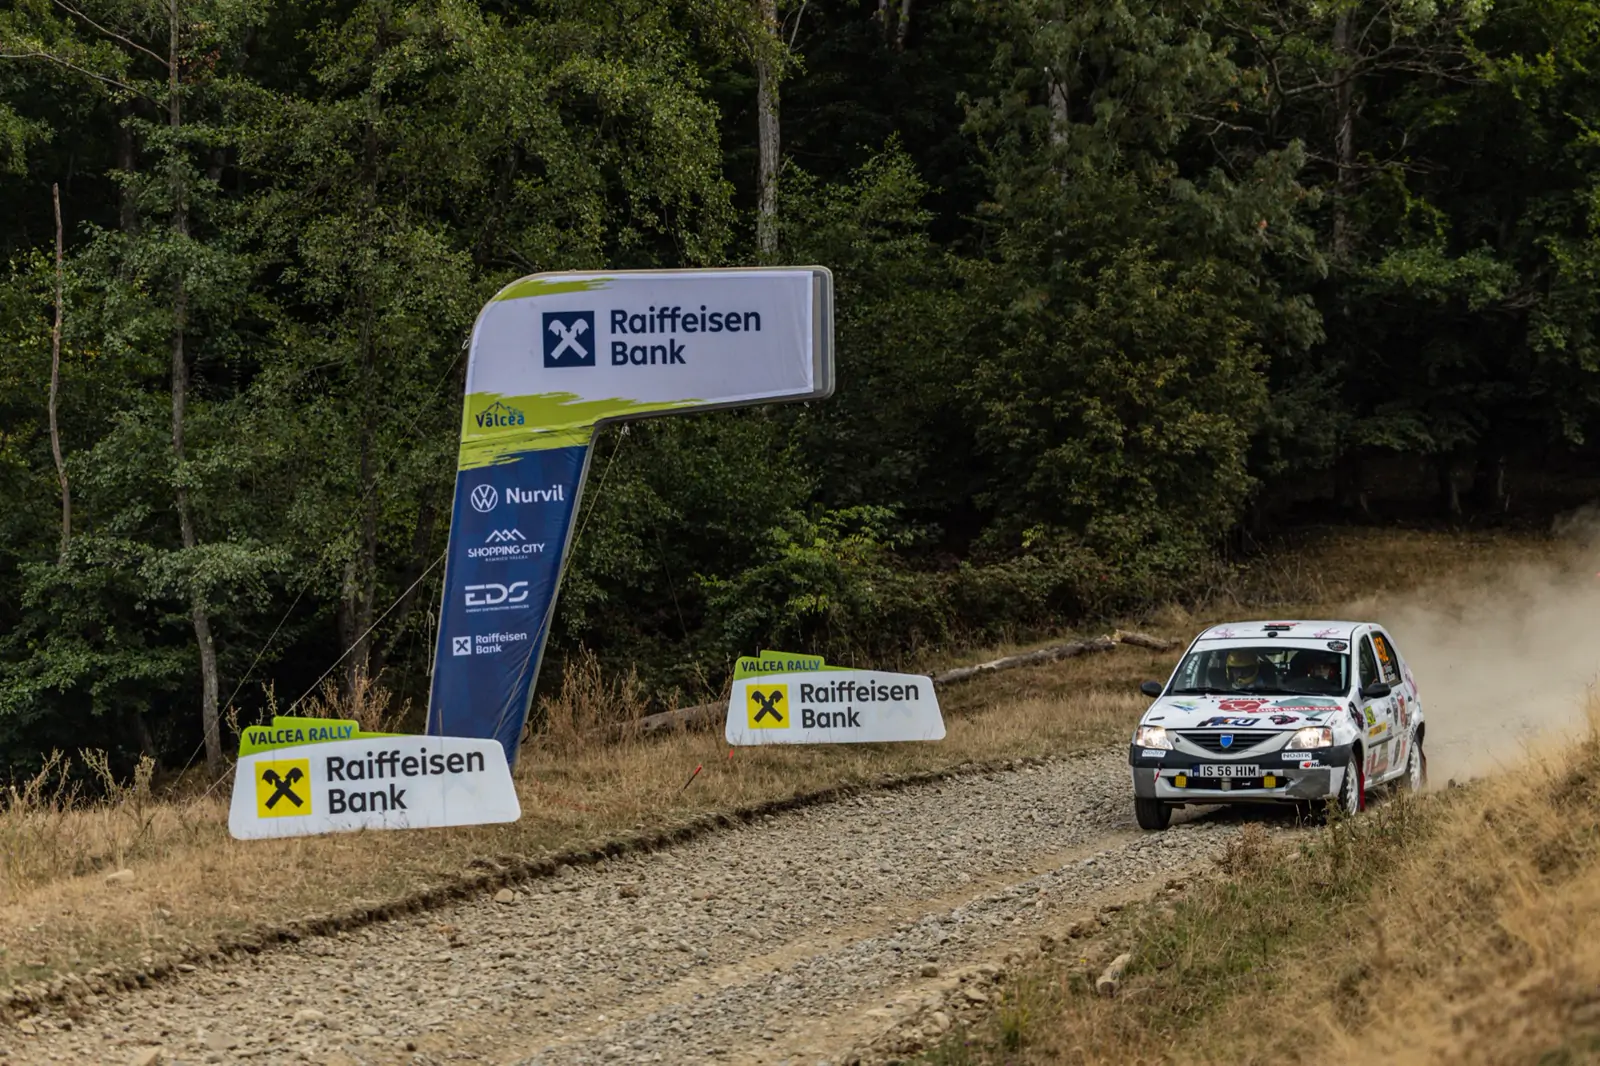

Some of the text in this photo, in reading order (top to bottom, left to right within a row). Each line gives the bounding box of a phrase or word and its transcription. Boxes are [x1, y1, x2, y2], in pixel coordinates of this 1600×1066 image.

[610, 305, 761, 334] Raiffeisen
[611, 338, 687, 366] Bank
[506, 484, 564, 504] Nurvil
[468, 543, 545, 557] SHOPPING CITY
[465, 581, 528, 606] EDS
[475, 632, 527, 645] Raiffeisen
[476, 644, 502, 655] Bank
[741, 660, 821, 672] VALCEA RALLY
[800, 679, 919, 703] Raiffeisen
[801, 707, 861, 728] Bank
[248, 725, 353, 746] VALCEA RALLY
[326, 747, 485, 782] Raiffeisen
[1203, 766, 1213, 776] IS
[1217, 766, 1232, 776] 56
[1235, 766, 1256, 776] HIM
[328, 784, 407, 814] Bank
